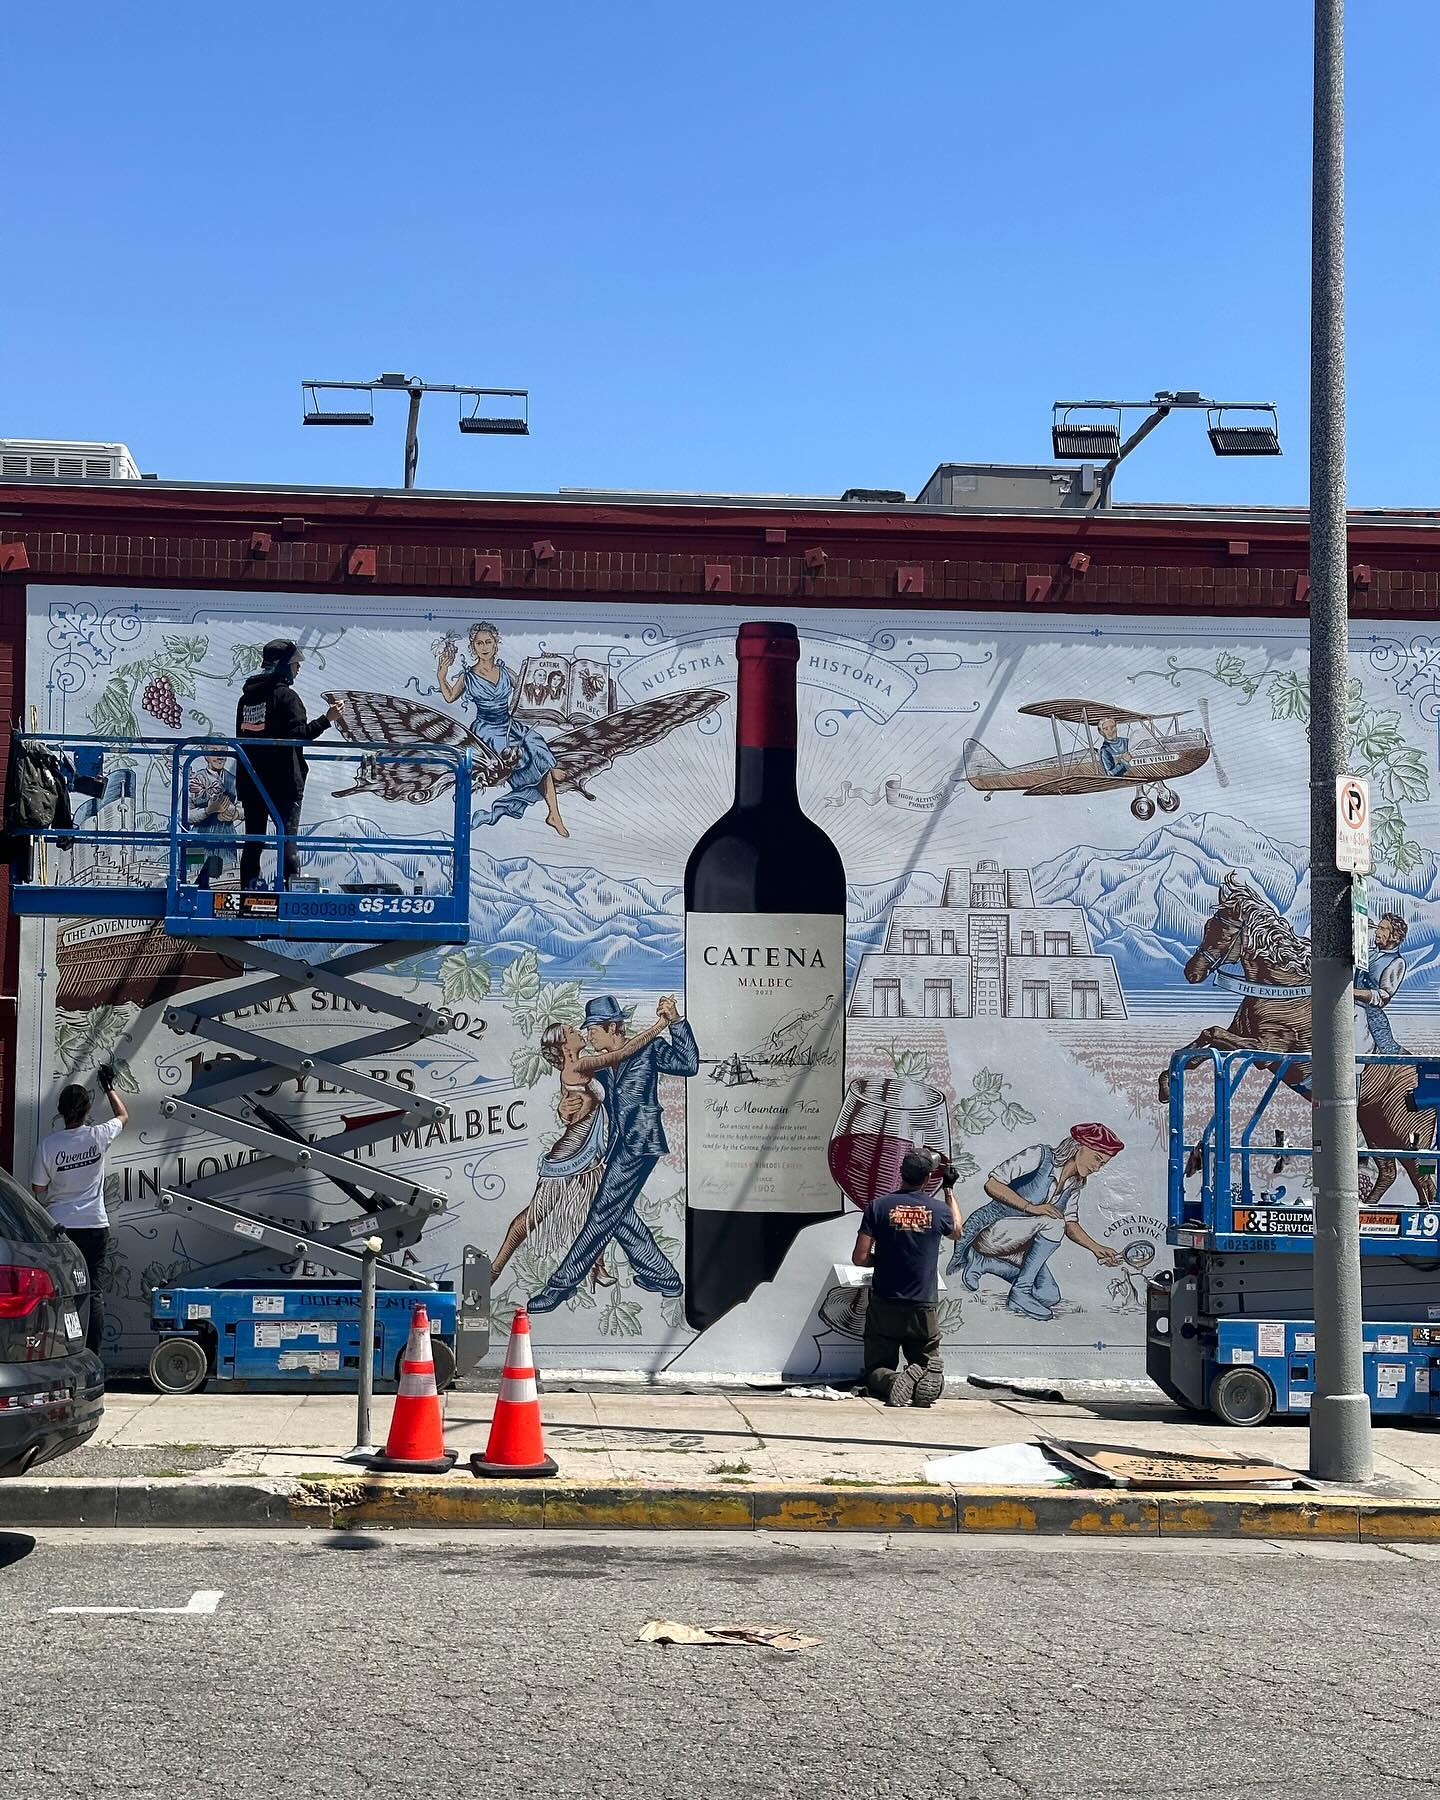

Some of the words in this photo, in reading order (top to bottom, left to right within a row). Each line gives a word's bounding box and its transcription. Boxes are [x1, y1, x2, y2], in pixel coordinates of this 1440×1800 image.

[641, 654, 725, 691] NUESTRA
[808, 655, 893, 697] HISTORIA
[576, 700, 601, 717] MALBEC
[66, 928, 87, 943] THE
[703, 946, 826, 968] CATENA
[738, 977, 793, 988] MALBEC
[1238, 984, 1257, 994] THE
[1260, 987, 1307, 996] EXPLORER
[704, 1099, 729, 1119] High
[734, 1101, 789, 1114] Mountain
[56, 1145, 99, 1166] Overall
[124, 1167, 161, 1201] IN
[392, 1100, 528, 1152] MALBEC
[1269, 1211, 1313, 1222] EQUIPM
[1103, 1216, 1137, 1238] CATENA
[1123, 1227, 1133, 1236] OF
[1137, 1226, 1162, 1240] WINE
[1269, 1222, 1313, 1232] SERVICE
